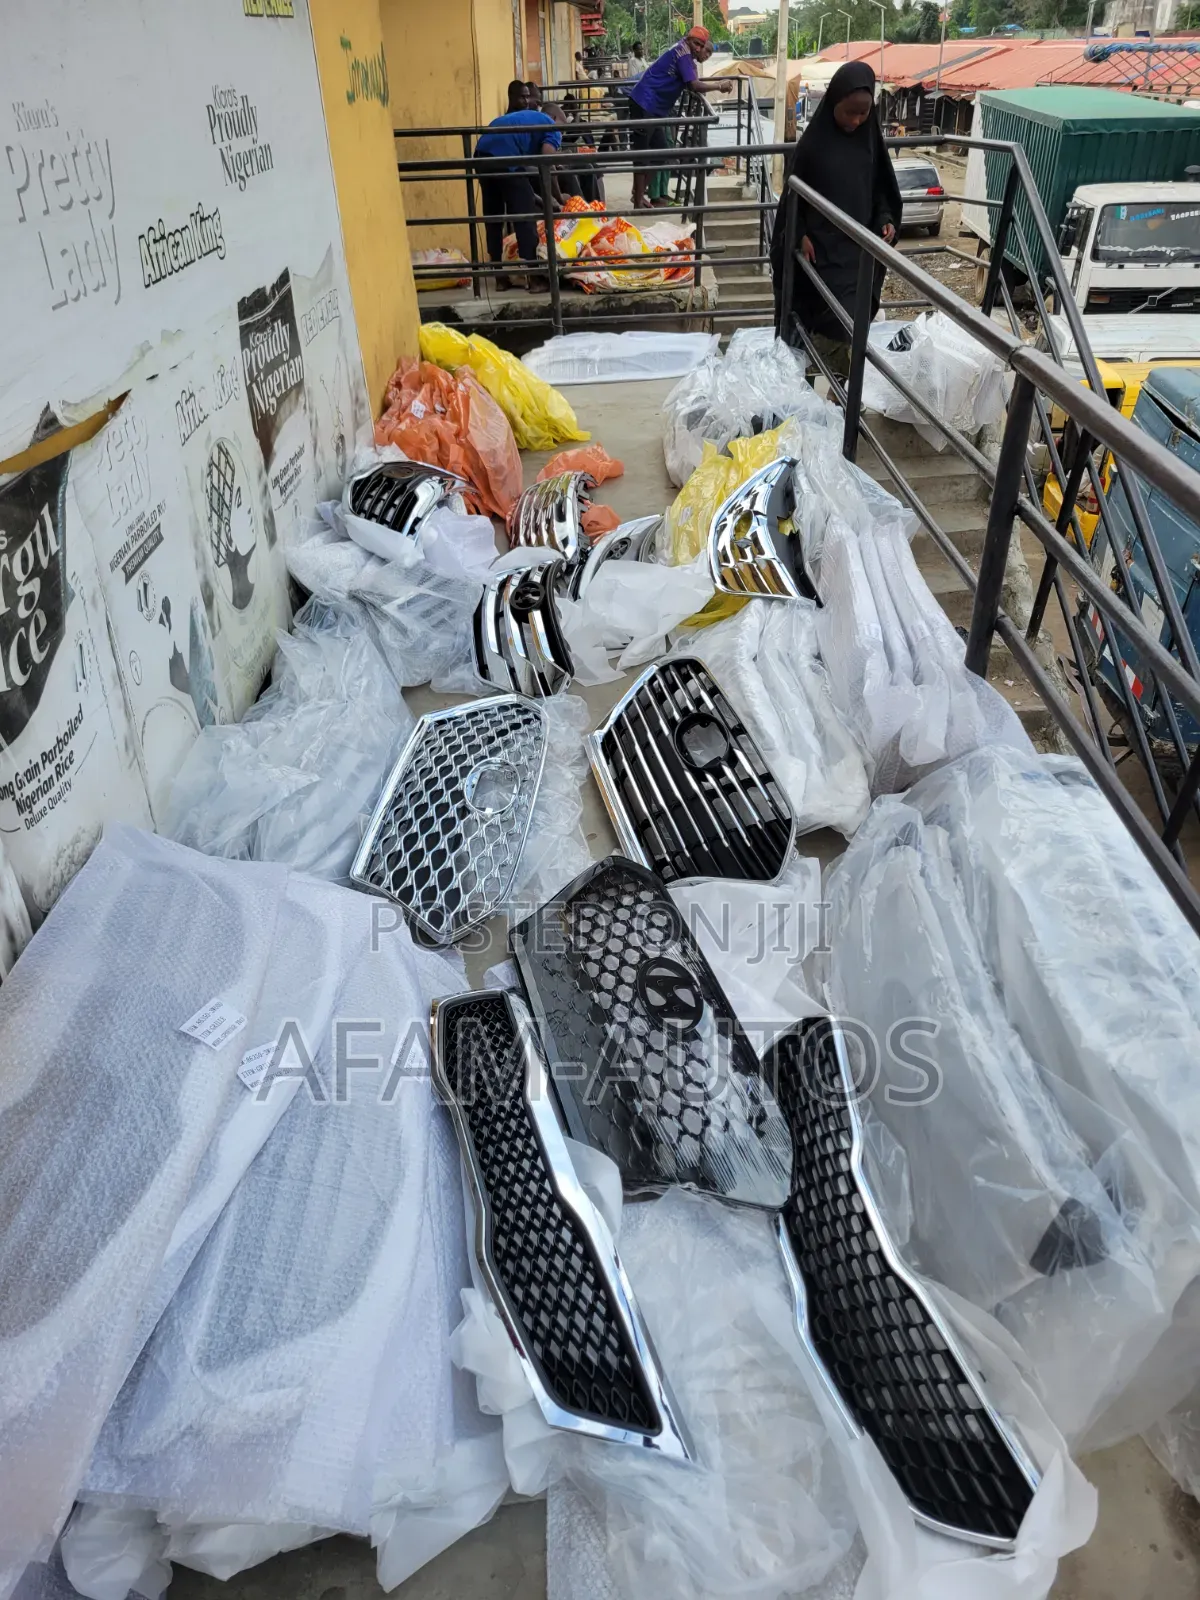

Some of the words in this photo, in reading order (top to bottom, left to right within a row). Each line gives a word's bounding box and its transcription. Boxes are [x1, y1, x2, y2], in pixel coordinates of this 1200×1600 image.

[205, 95, 260, 145] Proudly
[5, 130, 117, 223] Pretty
[218, 141, 275, 191] Nigerian
[38, 209, 121, 311] Lady
[138, 218, 193, 288] African
[190, 202, 226, 260] King
[242, 318, 290, 387] Proudly
[252, 355, 304, 420] Nigerian
[129, 509, 157, 547] PARBOILED
[40, 703, 84, 771] Parboiled
[16, 771, 55, 817] Nigerian
[54, 749, 76, 784] Rice
[24, 802, 49, 831] Deluxe
[46, 777, 72, 812] Quality
